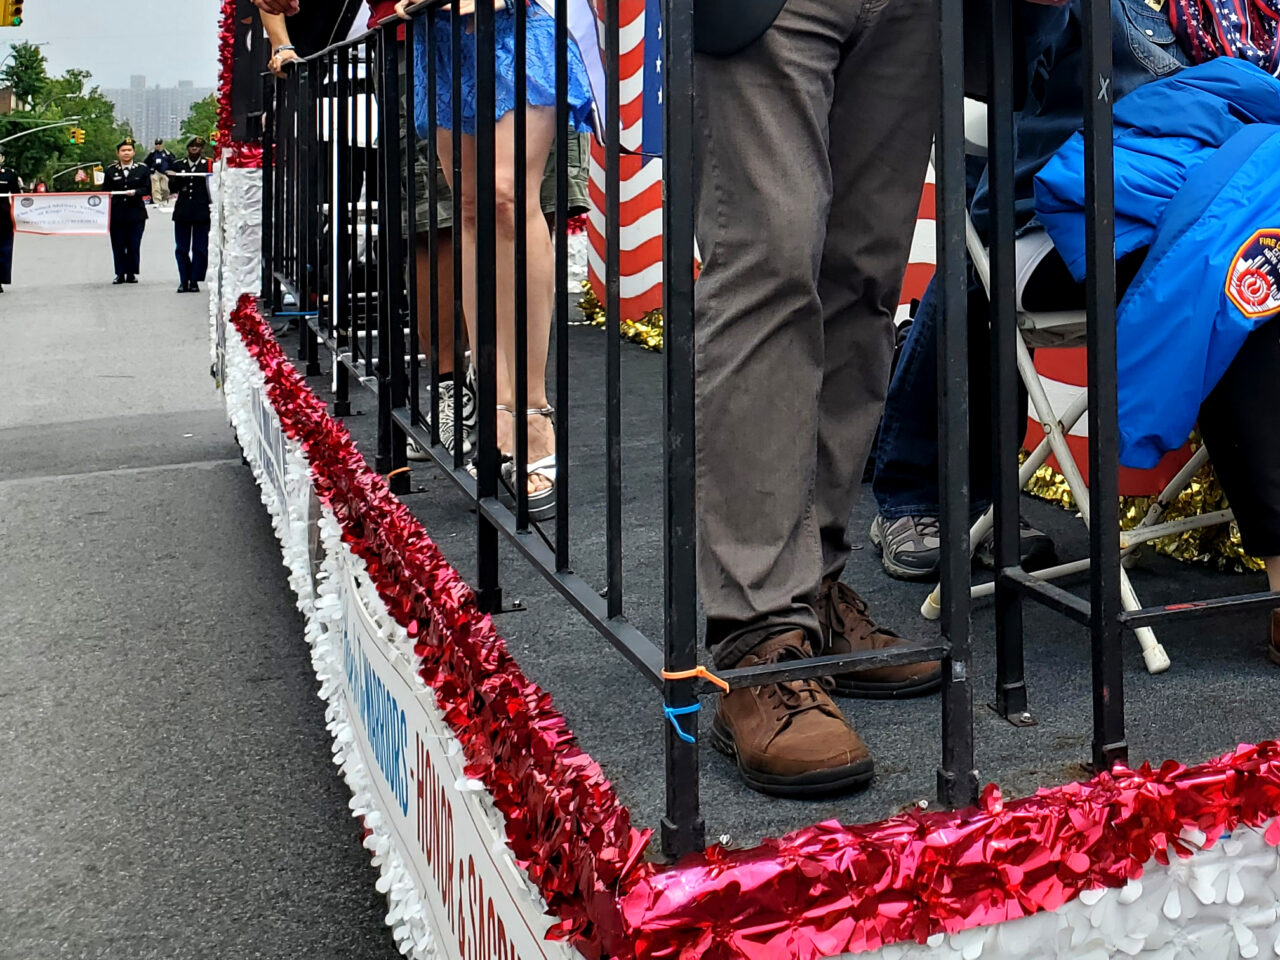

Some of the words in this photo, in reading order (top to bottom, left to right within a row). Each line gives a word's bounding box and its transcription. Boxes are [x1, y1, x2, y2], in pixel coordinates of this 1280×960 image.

[1259, 236, 1277, 247] FIRE
[1262, 247, 1279, 265] NEW
[415, 729, 455, 936] HONOR
